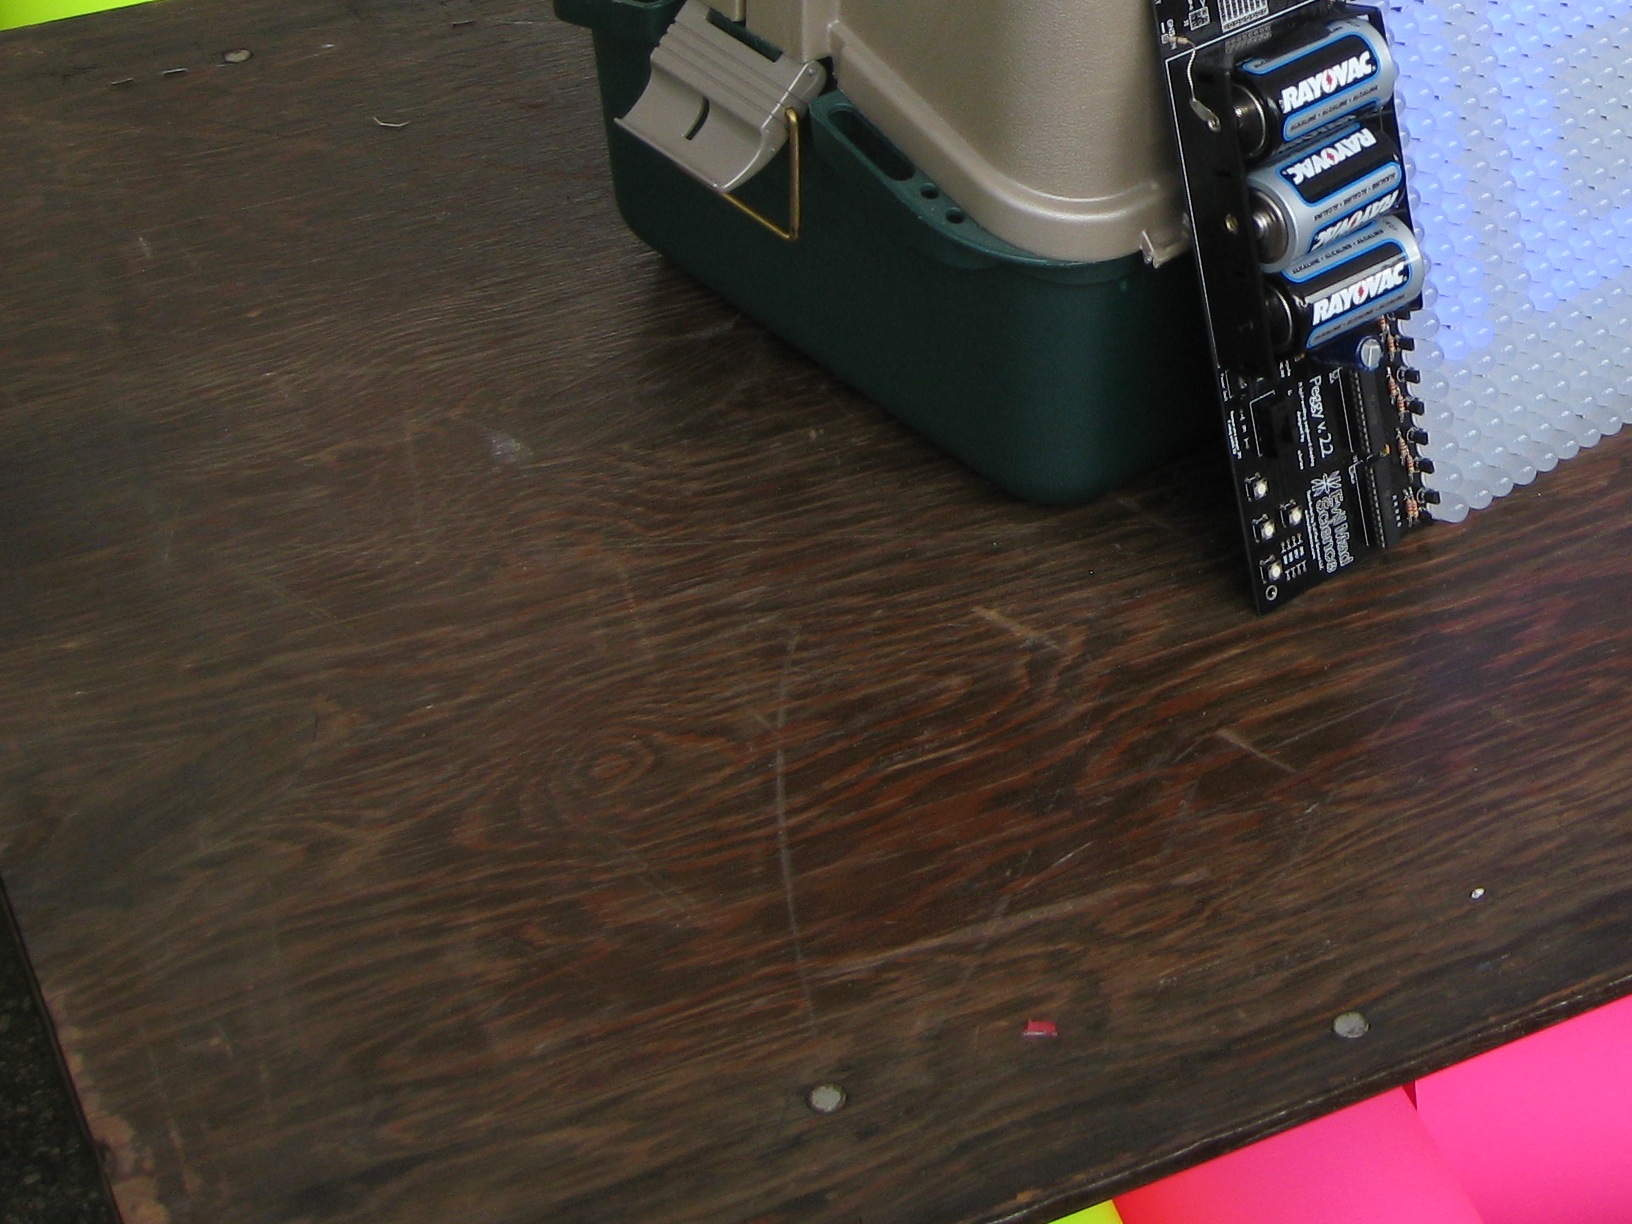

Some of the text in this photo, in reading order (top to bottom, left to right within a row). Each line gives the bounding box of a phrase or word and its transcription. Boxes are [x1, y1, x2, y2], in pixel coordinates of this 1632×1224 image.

[1281, 49, 1372, 114] RAYOVAC
[1286, 127, 1377, 185] RAYOVAC
[1312, 261, 1405, 326] RAYOVAC
[1308, 375, 1325, 419] Peggy
[1315, 498, 1338, 574] Science
